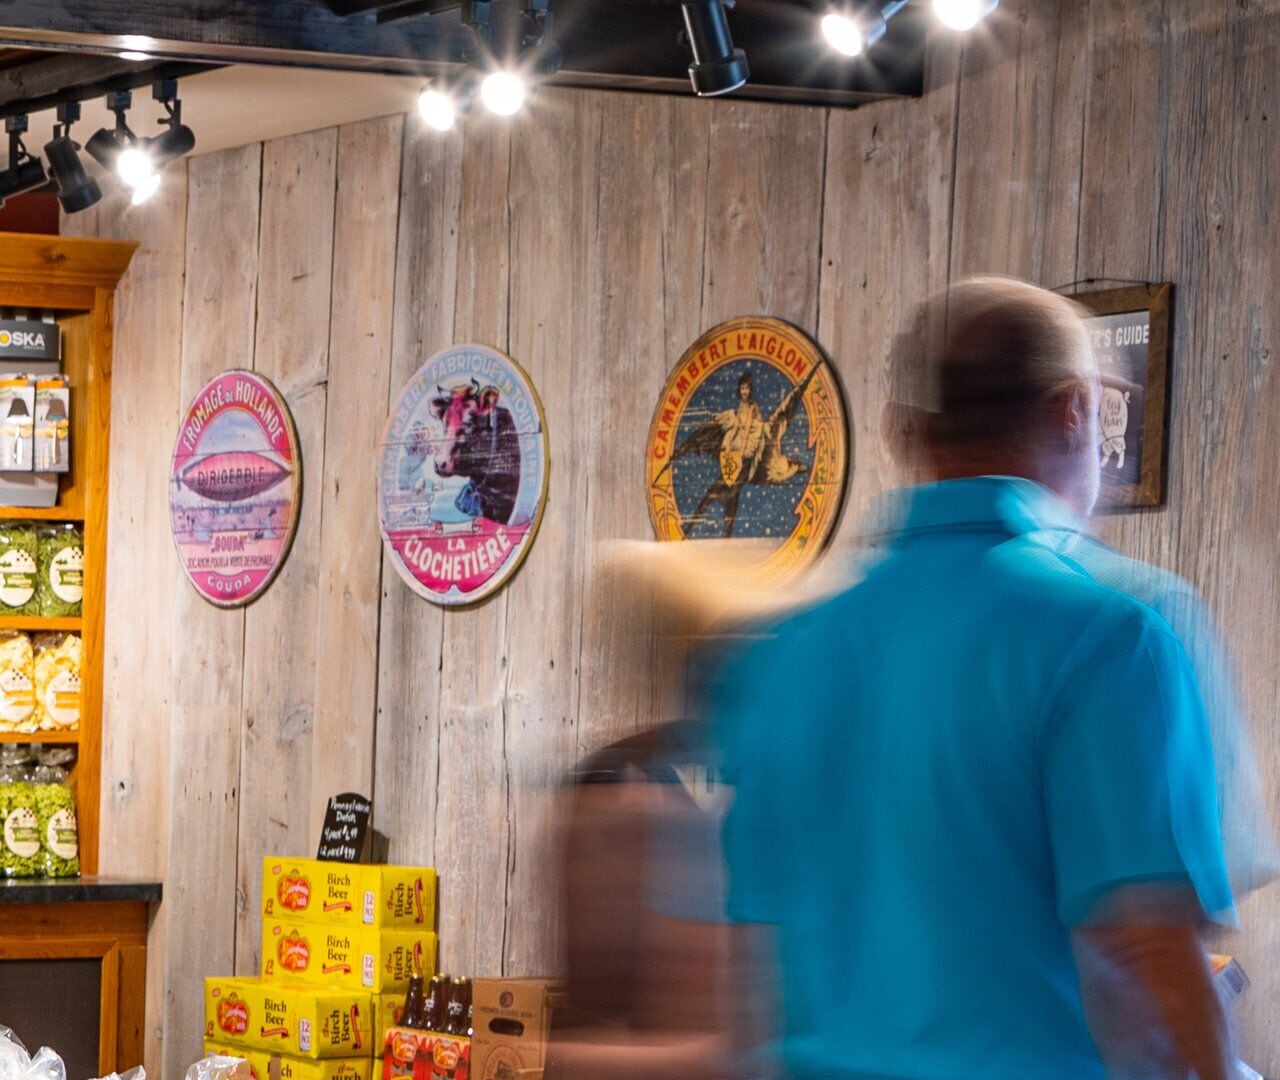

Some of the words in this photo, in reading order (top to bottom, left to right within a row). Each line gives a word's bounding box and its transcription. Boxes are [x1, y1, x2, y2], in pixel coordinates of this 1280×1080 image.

[1115, 324, 1150, 347] GUIDE
[654, 337, 728, 460] CAMEMBERT
[736, 332, 808, 378] L'AIGLON
[183, 384, 225, 452] FROMAGE
[235, 380, 284, 445] HOLLANDE
[447, 537, 467, 552] LA
[207, 574, 251, 593] GOUDA
[327, 872, 351, 887] Birch
[327, 886, 348, 900] Beer
[365, 892, 374, 902] 12
[394, 882, 405, 918] Birch
[404, 886, 414, 916] Beer
[326, 935, 350, 949] Birch
[327, 948, 348, 962] Beer
[364, 955, 374, 965] 12
[393, 946, 404, 981] Birch
[263, 998, 287, 1013] Birch
[265, 1011, 285, 1026] Beer
[301, 1019, 310, 1033] 12
[330, 1009, 340, 1045] Birch
[341, 1011, 351, 1043] Beer
